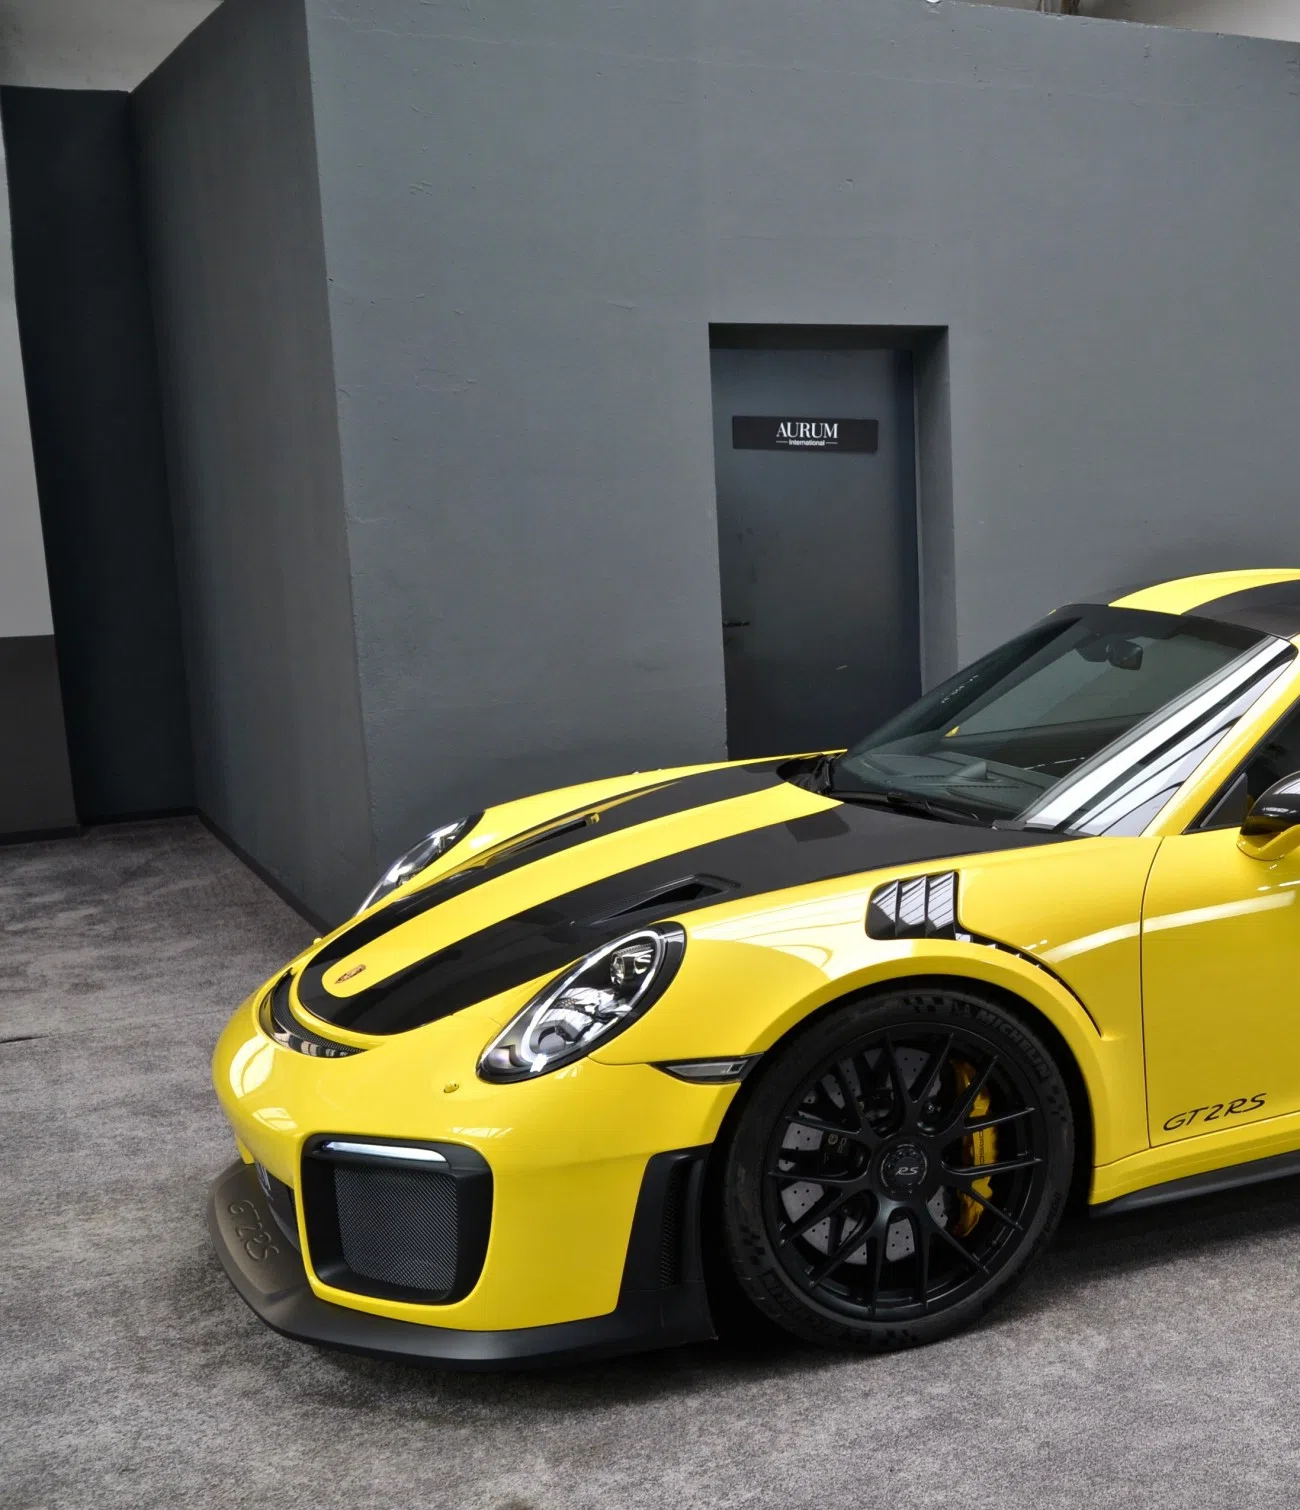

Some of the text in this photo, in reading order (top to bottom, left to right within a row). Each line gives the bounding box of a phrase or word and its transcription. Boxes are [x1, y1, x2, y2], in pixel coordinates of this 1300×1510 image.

[776, 422, 838, 438] AURUM
[975, 1008, 1052, 1080] MICHELIN
[895, 1166, 919, 1175] RS
